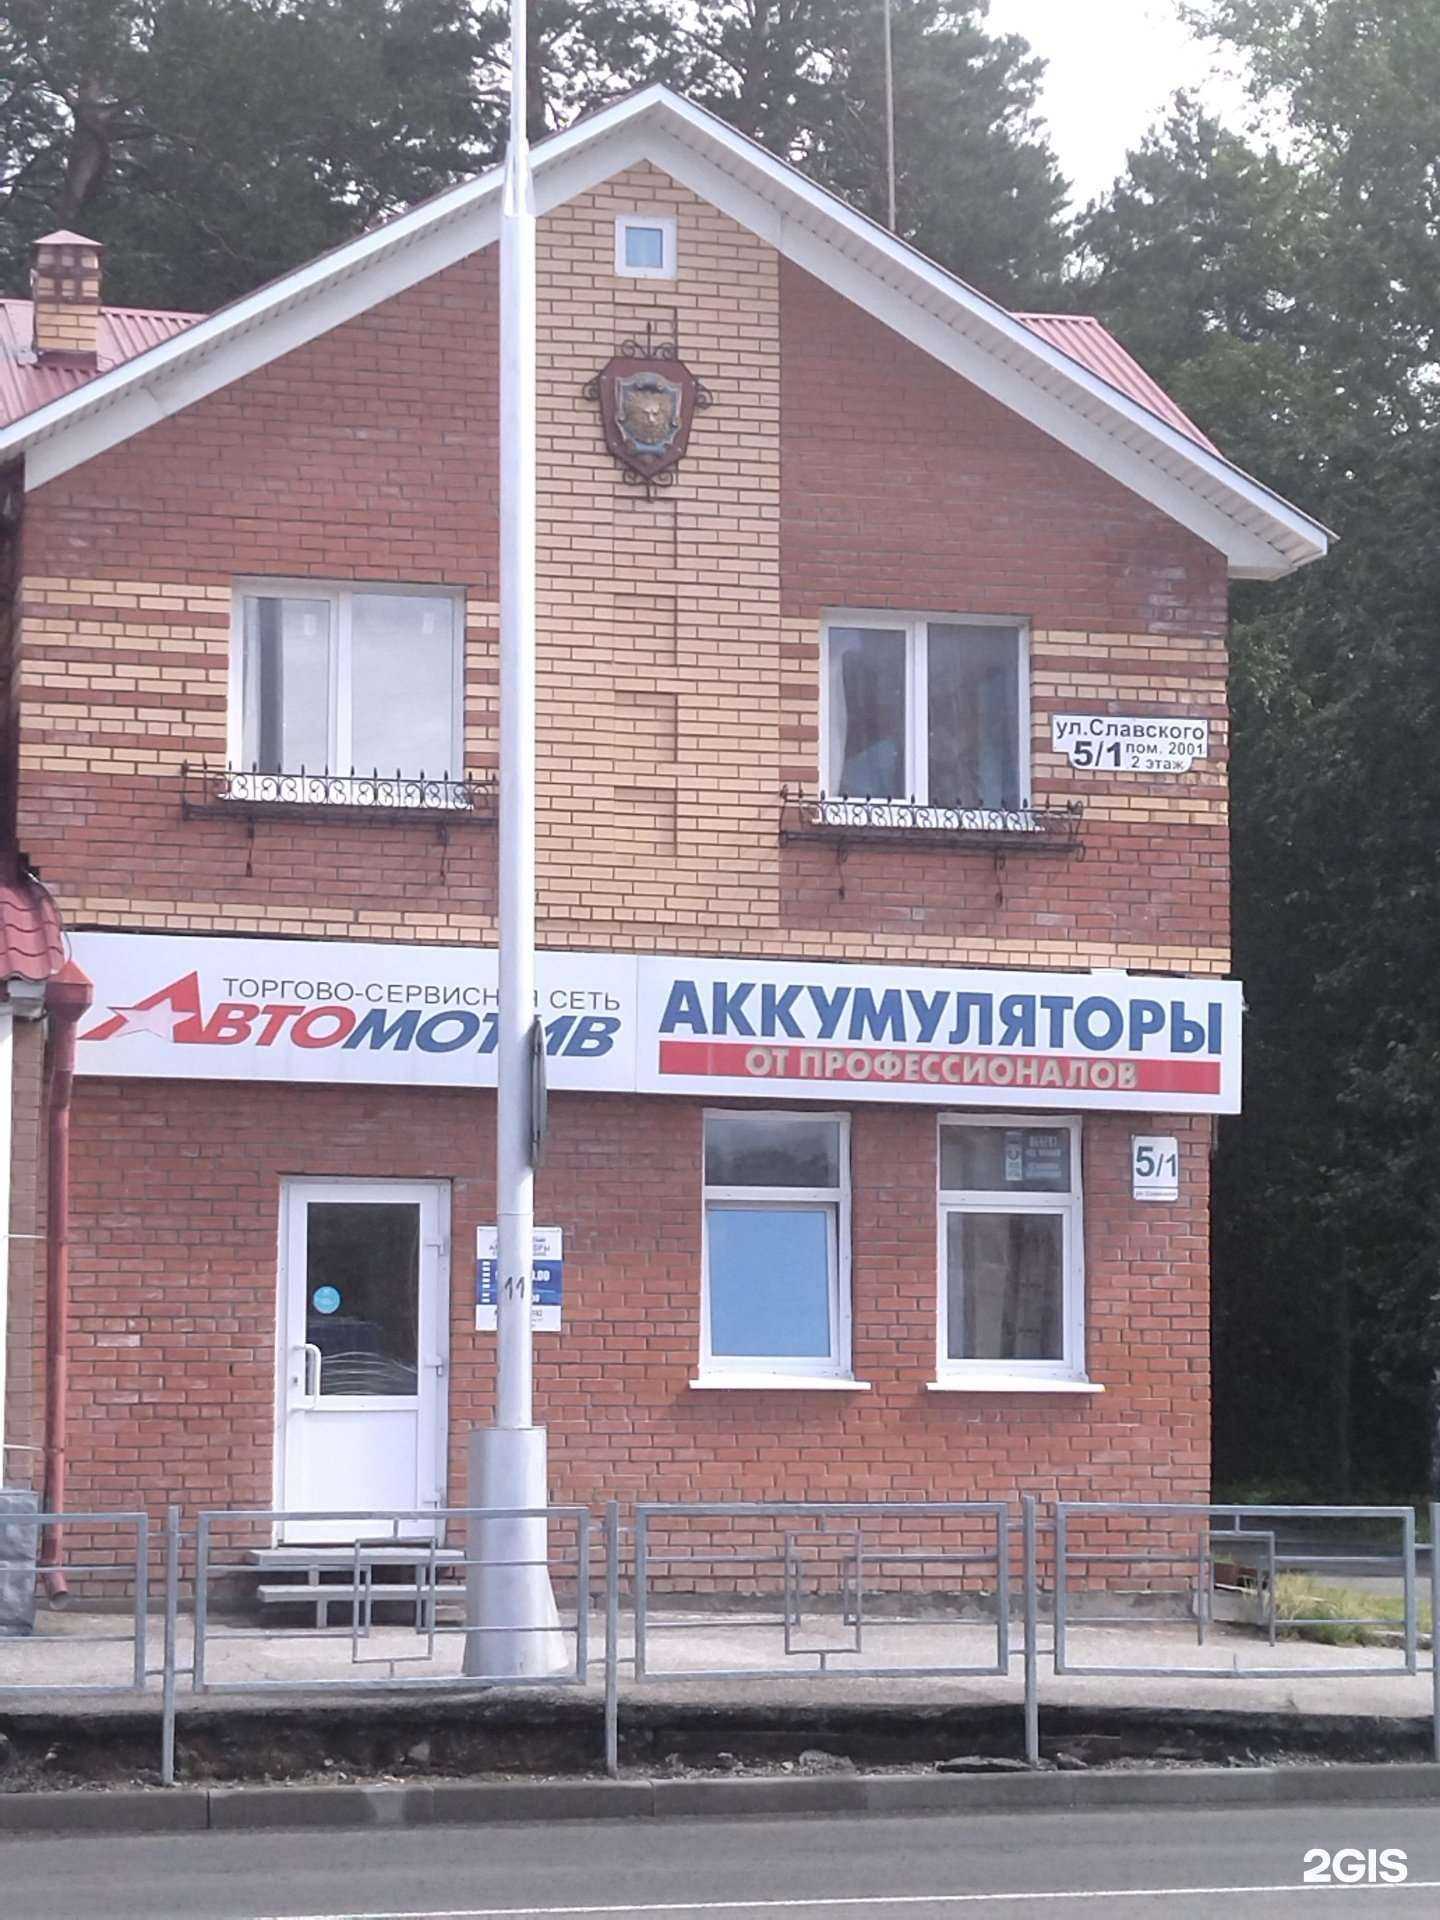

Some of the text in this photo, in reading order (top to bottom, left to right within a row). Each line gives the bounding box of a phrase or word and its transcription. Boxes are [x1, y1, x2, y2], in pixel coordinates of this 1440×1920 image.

[1056, 719, 1204, 740] ул.Славского
[1074, 741, 1121, 767] 5/1
[1126, 743, 1203, 755] пом. 2001
[1131, 756, 1184, 770] 2 этаж
[223, 977, 621, 1011] ТОРГОВО-СЕРВИСН СЕТЬ
[659, 980, 1221, 1055] АККУМУЛЯТОРЫ
[745, 1047, 1137, 1089] ОТ ПРОФЕССИОНАЛОВ
[1135, 1146, 1176, 1177] 5/1
[505, 1276, 525, 1299] 11
